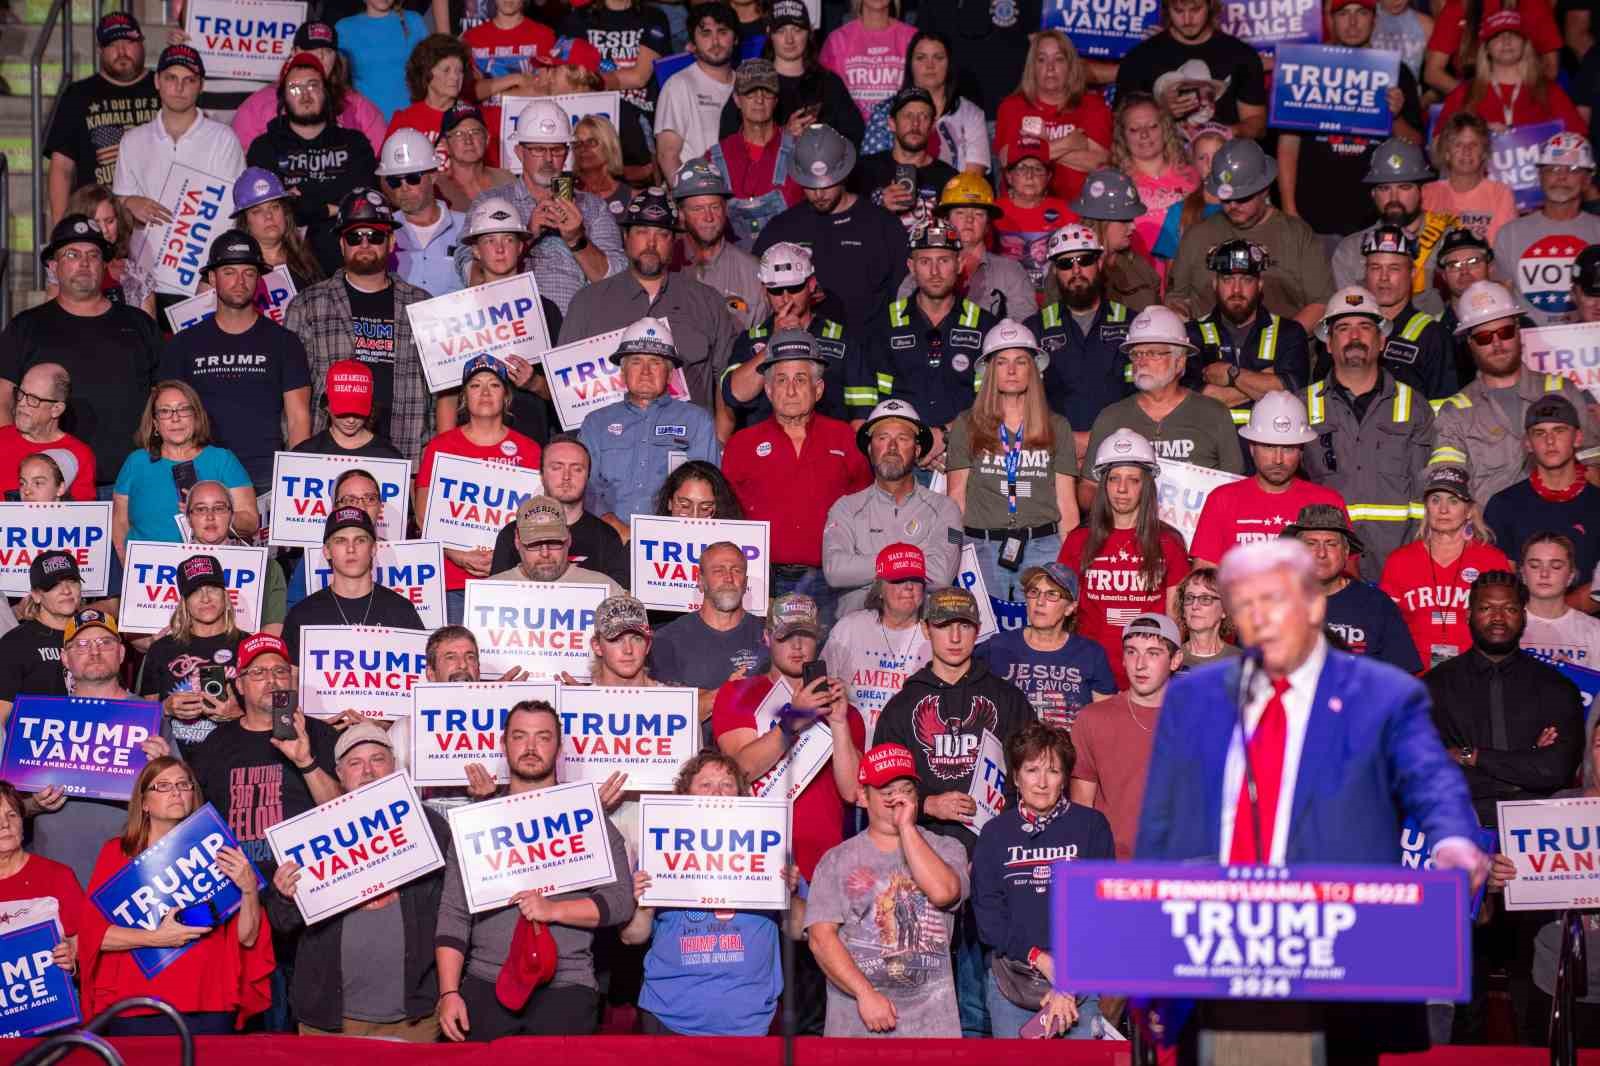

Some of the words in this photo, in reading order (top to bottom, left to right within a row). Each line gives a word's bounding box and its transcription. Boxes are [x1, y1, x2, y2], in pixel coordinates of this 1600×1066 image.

[1061, 11, 1143, 31] VANCE
[1228, 0, 1313, 21] RUMP
[194, 15, 297, 41] TRUMP
[205, 35, 283, 55] VANCE
[1280, 63, 1390, 88] TRUMP
[1291, 84, 1375, 107] VANCE
[1305, 102, 1334, 111] AMERICA
[86, 111, 135, 129] KAMALA
[287, 149, 350, 173] TRUMP
[162, 190, 203, 270] VANCE
[177, 185, 225, 287] TRUMP
[438, 319, 527, 356] VANCE
[195, 354, 267, 368] TRUMP
[1531, 346, 1600, 371] TRU
[208, 366, 230, 374] AMERICA
[555, 356, 622, 387] TRU
[439, 477, 533, 511] TRUM
[286, 515, 307, 524] MAKE
[449, 500, 518, 527] VANC
[524, 506, 562, 521] AMERICA
[439, 518, 463, 528] MAKE
[464, 521, 491, 533] AMERICA
[0, 526, 103, 548] RUMP
[134, 563, 256, 589] TRP
[648, 580, 668, 588] MAKE
[137, 602, 161, 610] MAKE
[1104, 594, 1128, 602] America
[1405, 585, 1471, 612] TRUM
[489, 630, 583, 651] VANCE
[39, 648, 60, 661] YOU
[480, 648, 505, 658] MAKE
[879, 658, 905, 671] MAKE
[1001, 663, 1082, 683] JESUS
[317, 689, 340, 698] MAKE
[342, 690, 373, 699] AMERICA
[376, 691, 401, 699] GREAT
[857, 688, 888, 702] GREAT
[1036, 680, 1080, 695] SAVIOR
[19, 717, 148, 747] TRUMP
[421, 709, 503, 734] TRU
[562, 712, 687, 737] TRUMP
[30, 741, 130, 767] VANCE
[436, 734, 495, 756] VAN
[573, 737, 672, 756] VANCE
[19, 758, 42, 768] MAKE
[43, 760, 75, 771] AMERICA
[77, 764, 105, 774] GREAT
[108, 767, 135, 775] AGAIN!
[428, 752, 450, 760] MAKE
[453, 752, 485, 760] AMERICA
[565, 756, 585, 764] MAKE
[587, 756, 621, 764] AMERICA
[651, 757, 679, 765] AGAIN!
[868, 752, 886, 763] MAKE
[248, 765, 282, 784] VOTING
[875, 761, 894, 773] GREAT
[231, 785, 259, 808] FOR
[261, 781, 283, 807] THE
[286, 797, 410, 866] TRUMP
[465, 807, 594, 856] TRUMP
[649, 828, 781, 853] TRUMP
[1510, 828, 1600, 853] TRU
[308, 826, 408, 881] VANCE
[485, 834, 586, 873] VANCE
[541, 860, 566, 871] GREAT
[568, 854, 594, 865] AGAIN!
[664, 852, 766, 874] VANCE
[1008, 843, 1078, 863] Trump
[1528, 853, 1593, 873] VAN
[113, 831, 225, 927] TRUMP
[309, 879, 331, 894] MAKE
[331, 868, 365, 886] AMERICA
[366, 857, 392, 873] GREAT
[392, 846, 419, 863] AGAIN!
[656, 873, 677, 881] MAKE
[679, 874, 716, 882] AMERICA
[1548, 874, 1586, 882] AMERICA
[361, 881, 385, 897] 2024
[1158, 881, 1317, 901] PENNSYLVANIA
[1320, 883, 1351, 901] TO
[701, 897, 726, 906] 2024
[1161, 902, 1357, 938] TRUMP
[1184, 934, 1337, 967] VANCE
[1229, 975, 1291, 998] 2024
[4, 1002, 29, 1016] GREAT
[31, 993, 59, 1011] AGAIN!
